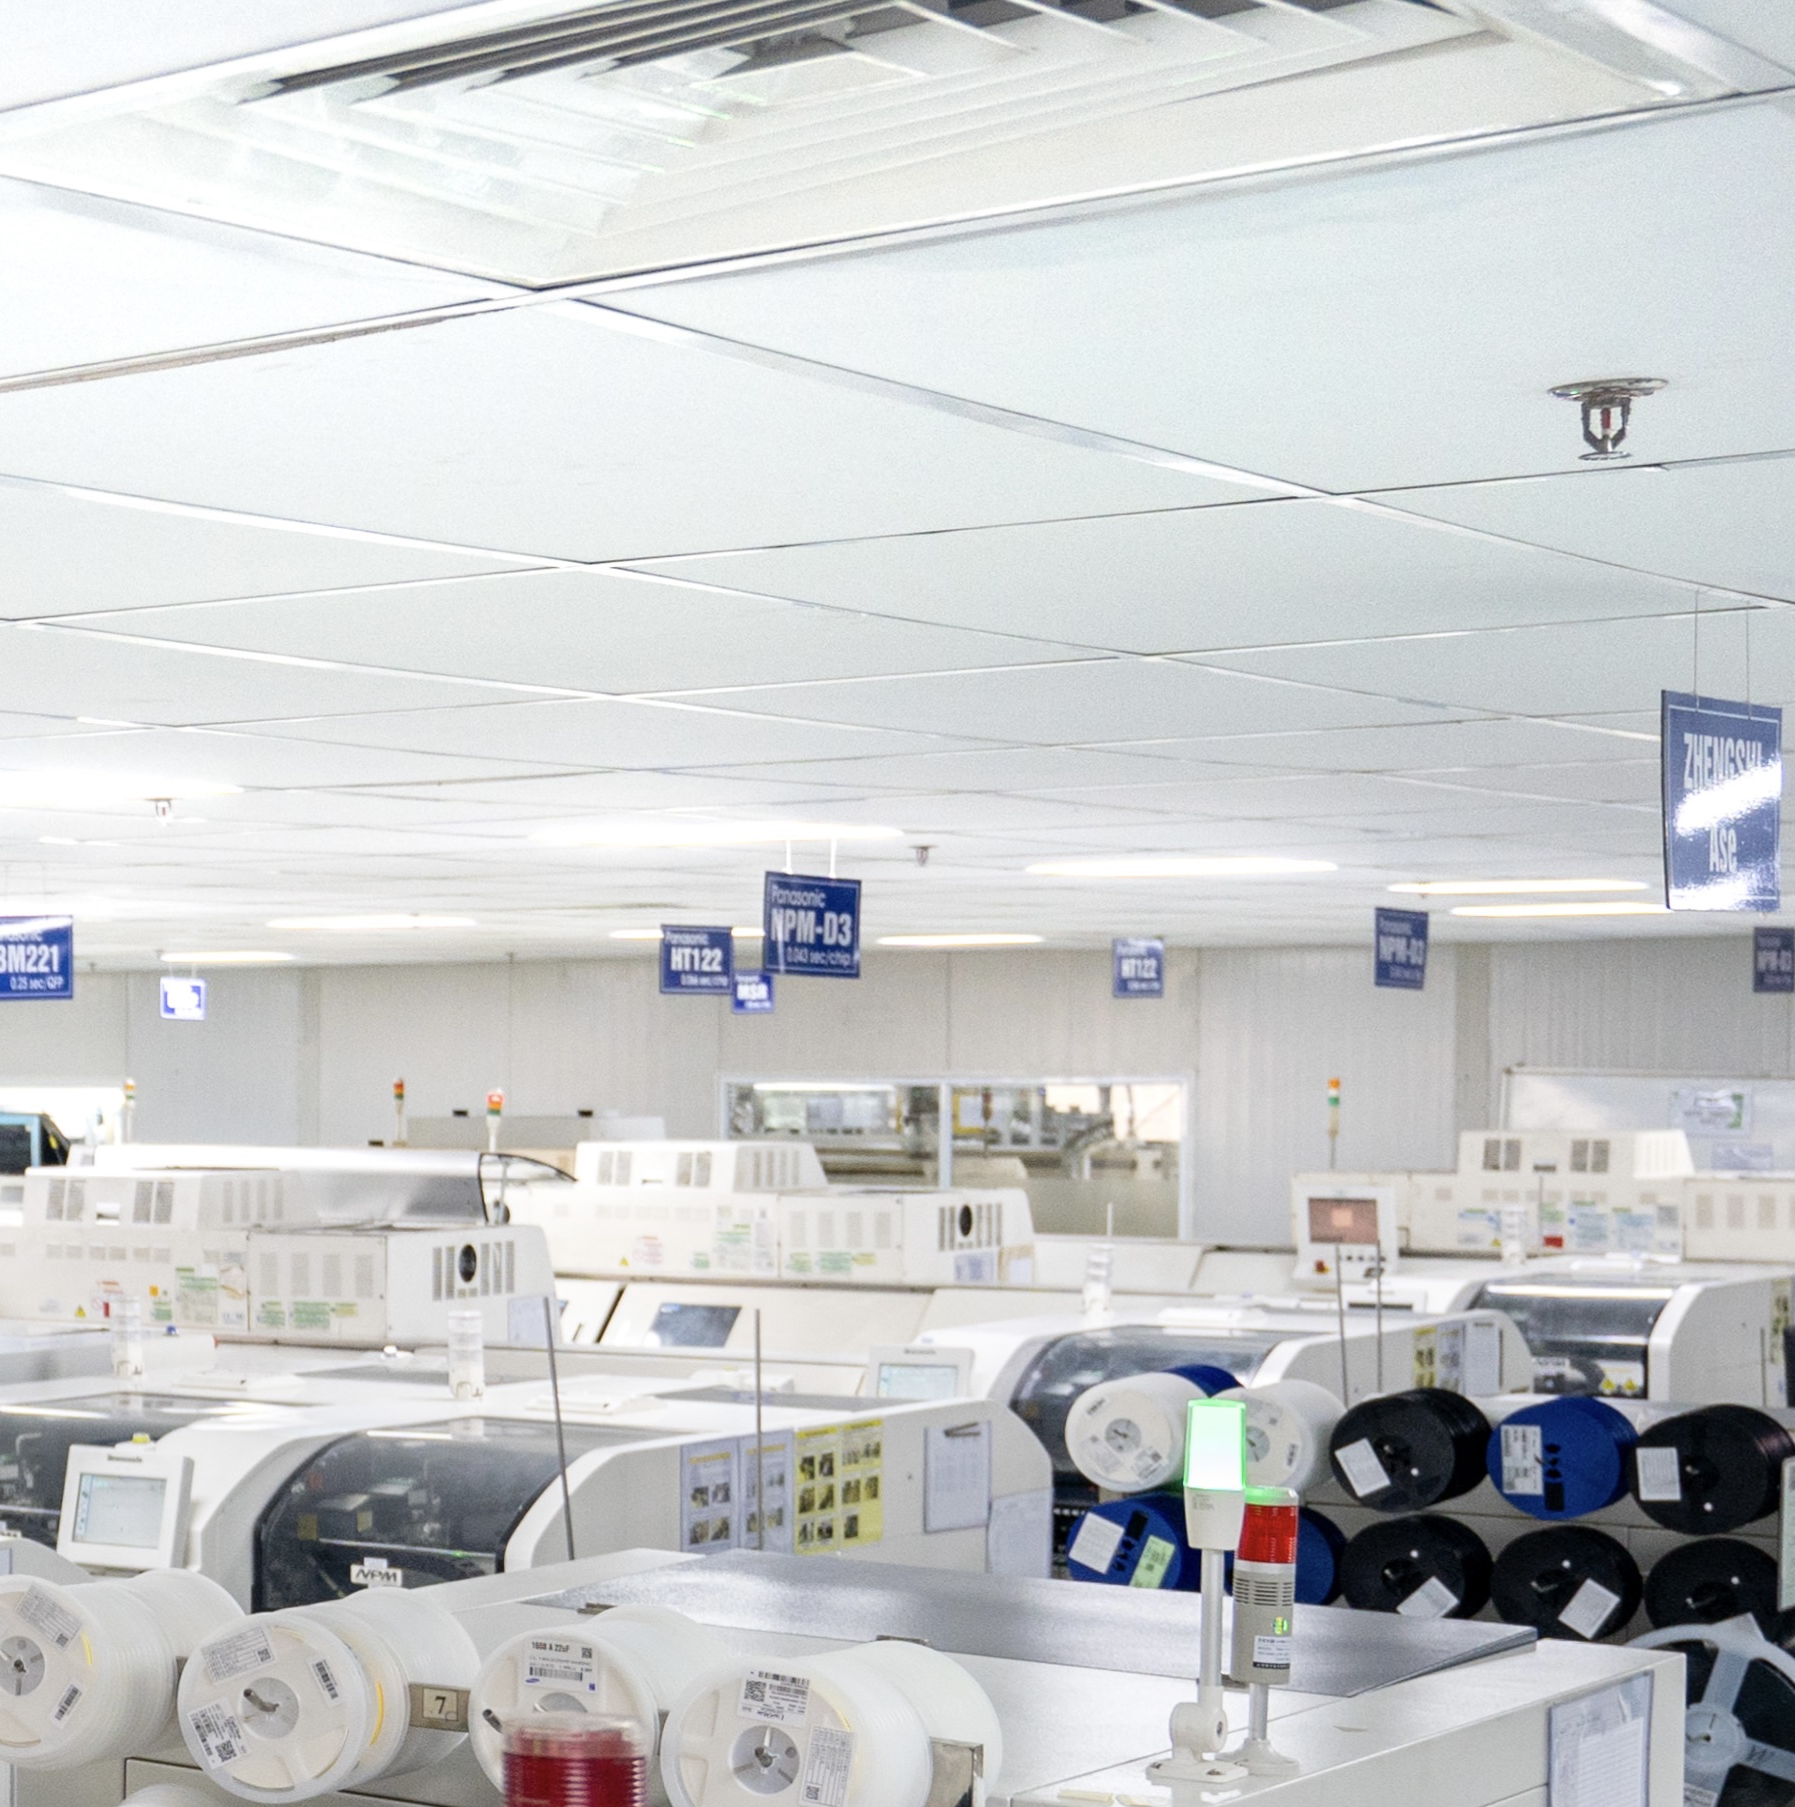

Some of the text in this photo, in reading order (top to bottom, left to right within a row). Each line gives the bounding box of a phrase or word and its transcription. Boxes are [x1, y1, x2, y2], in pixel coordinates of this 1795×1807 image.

[1710, 827, 1738, 874] Ase
[771, 884, 827, 908] Panasonic
[771, 907, 852, 946] NPM-D3
[670, 947, 722, 972] HT122
[355, 1569, 398, 1583] NPM
[434, 1695, 447, 1715] 7
